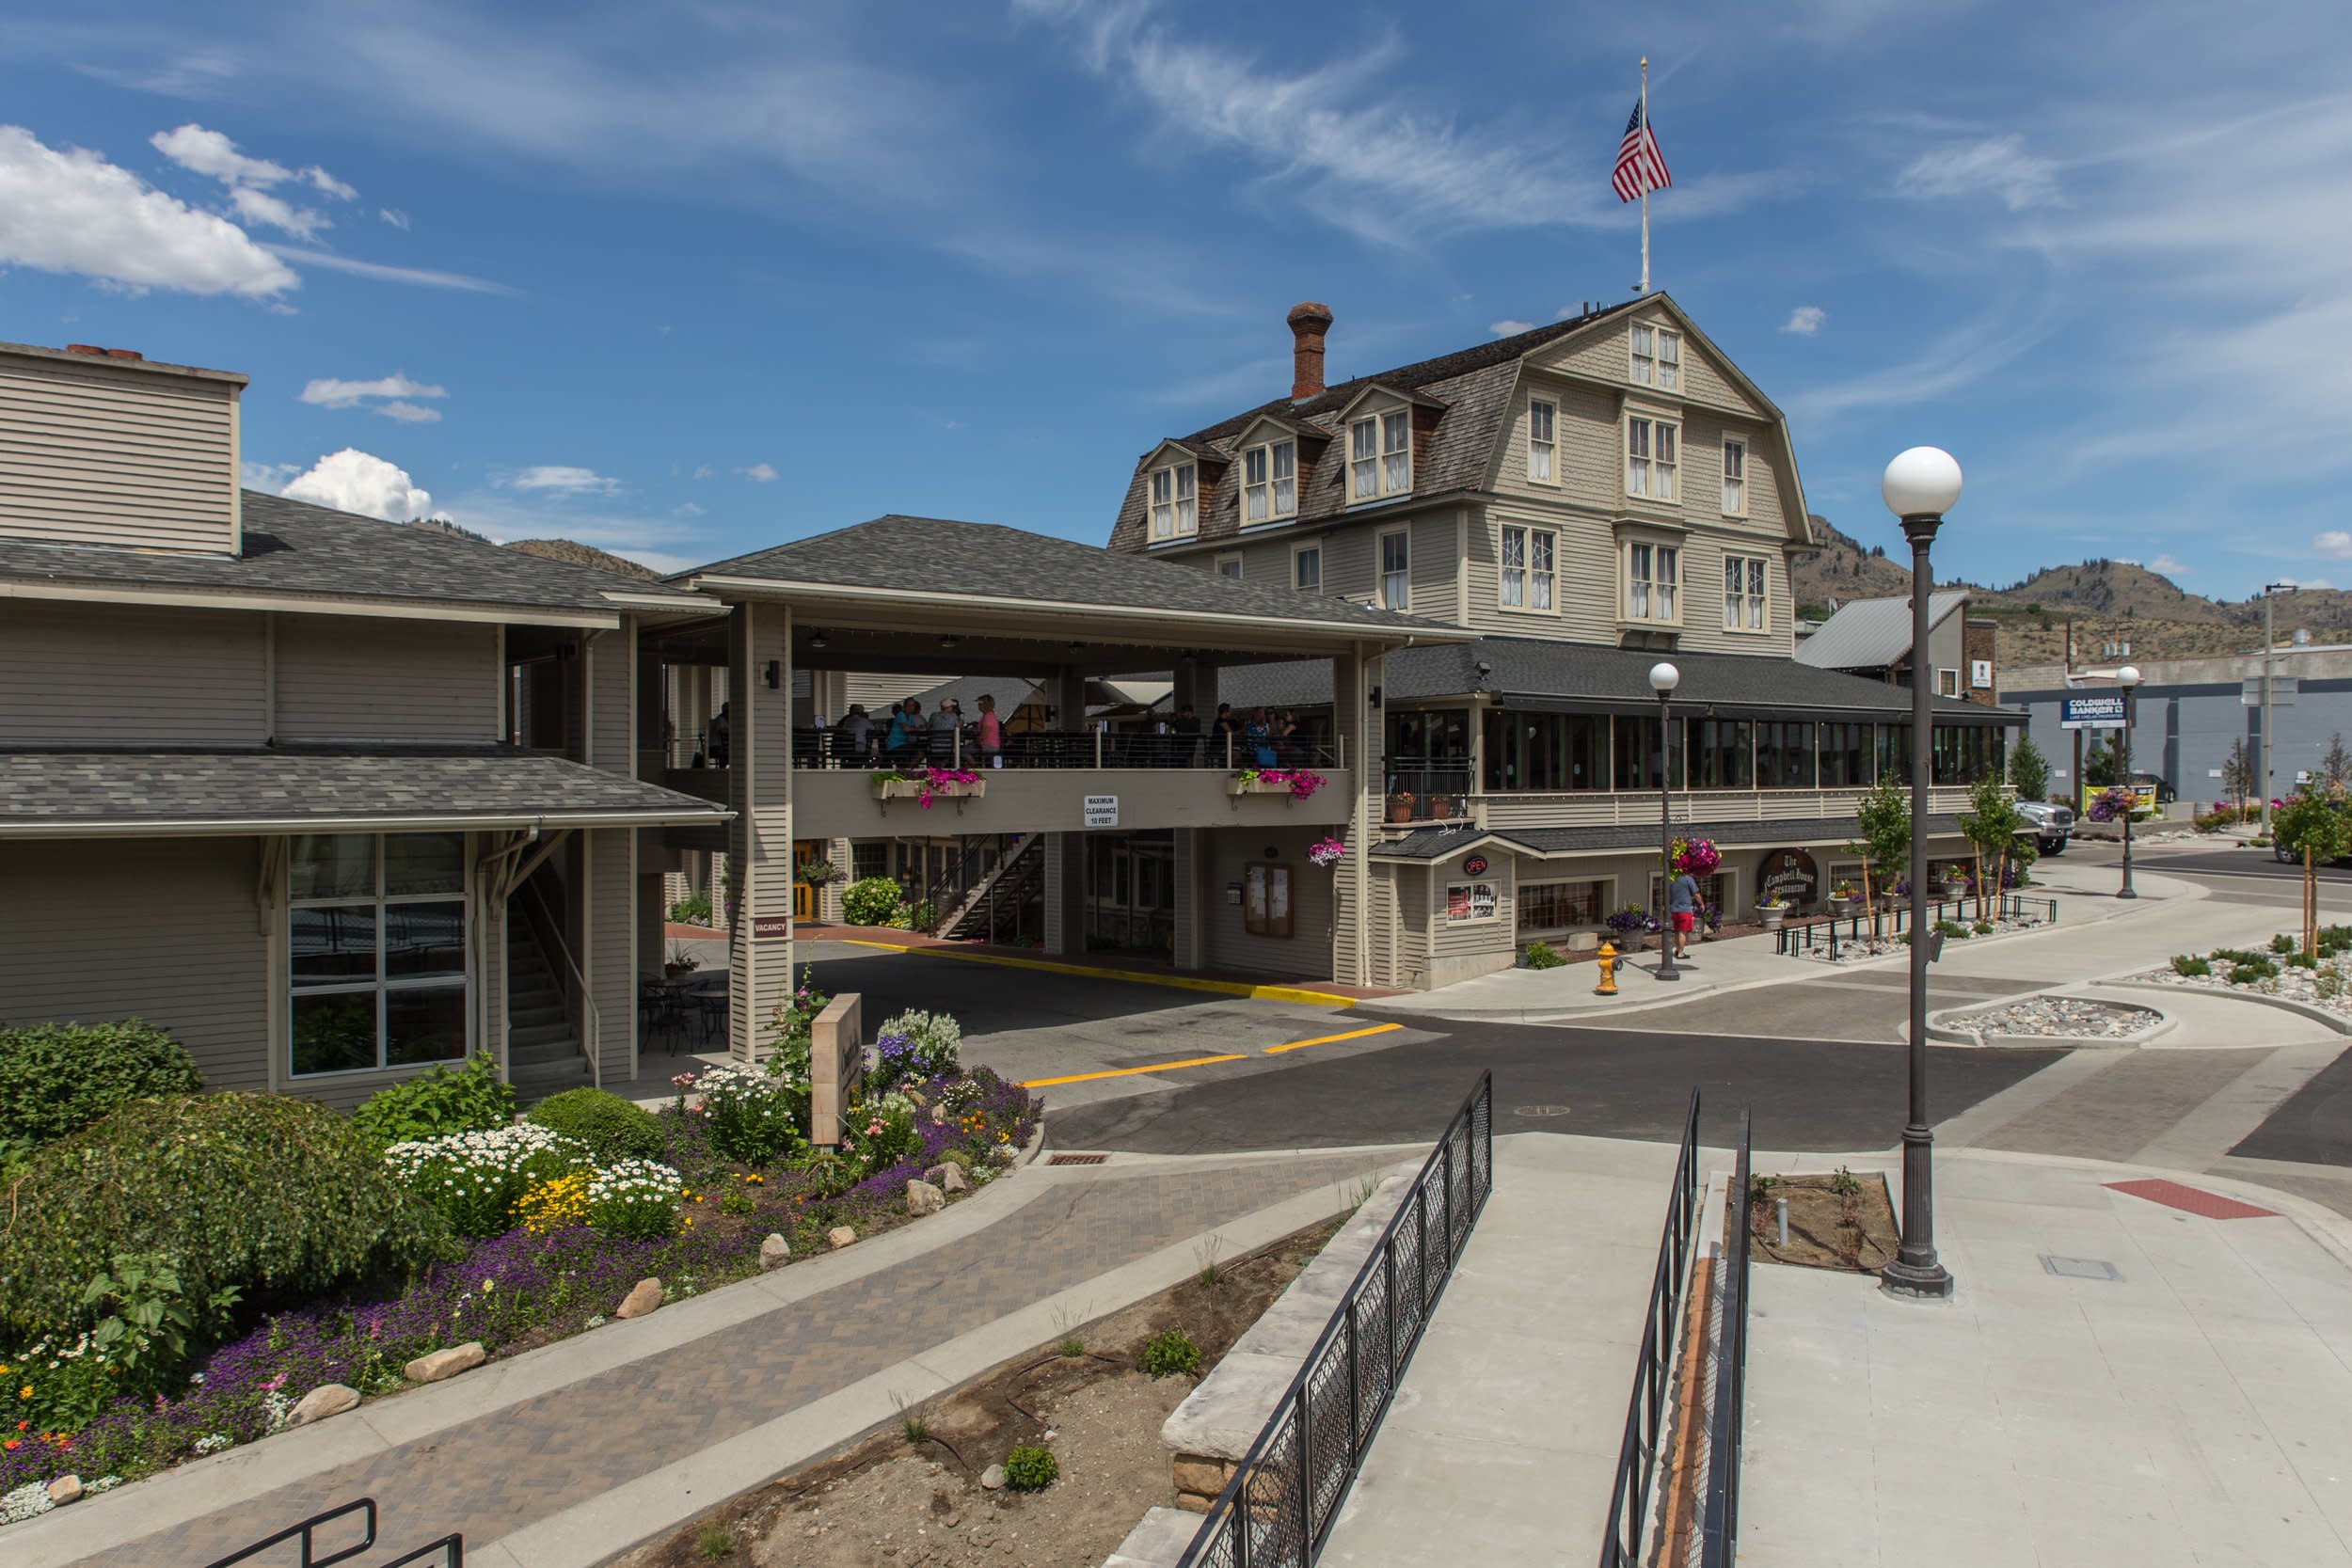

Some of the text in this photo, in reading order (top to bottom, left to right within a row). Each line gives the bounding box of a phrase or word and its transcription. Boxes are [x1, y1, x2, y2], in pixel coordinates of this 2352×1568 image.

[2070, 698, 2123, 707] COLDWELL
[2070, 705, 2114, 715] BANKER
[1784, 854, 1797, 867] The
[1466, 860, 1486, 874] OPEN
[1767, 867, 1814, 887] Campbell House
[755, 923, 787, 932] VACANCY
